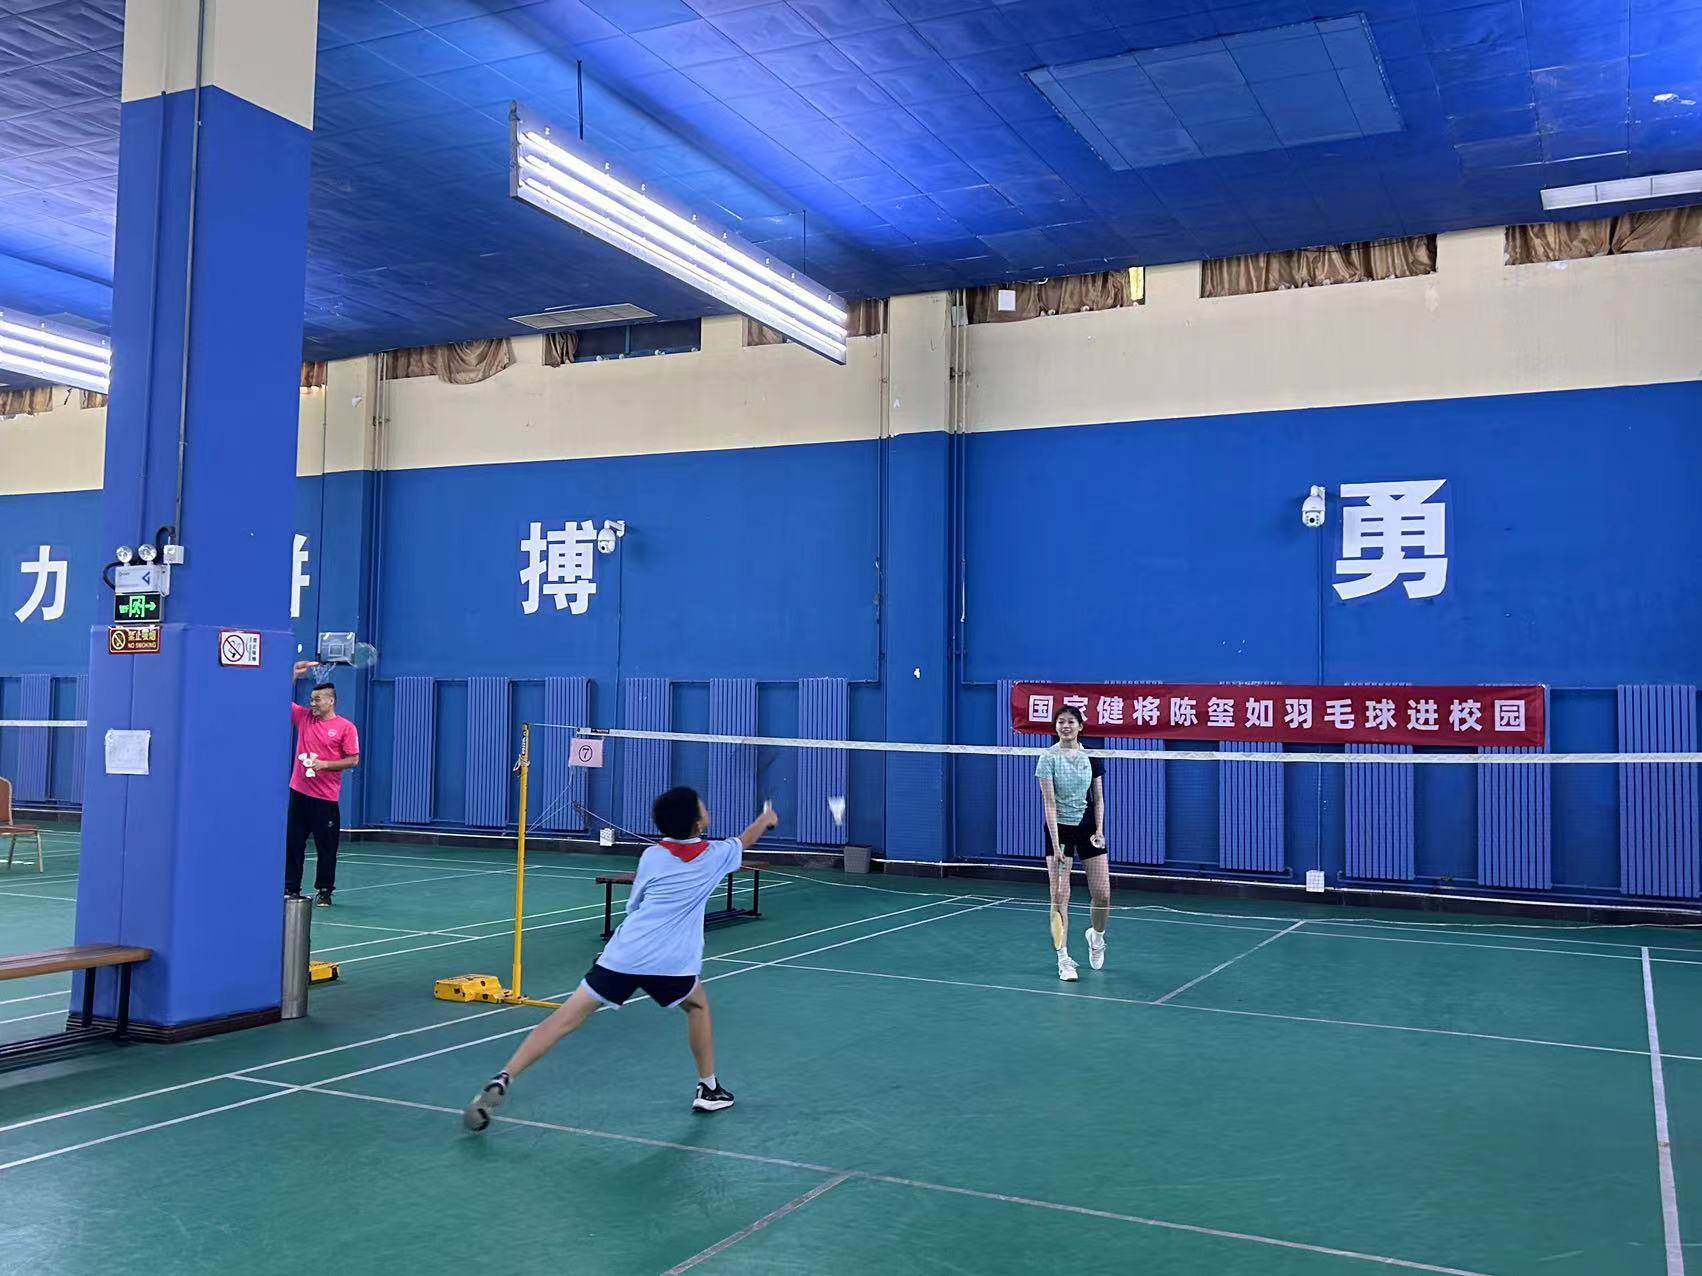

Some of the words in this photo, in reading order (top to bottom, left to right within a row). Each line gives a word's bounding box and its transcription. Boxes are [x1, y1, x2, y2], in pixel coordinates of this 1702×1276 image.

[14, 545, 68, 623] 力
[519, 520, 597, 615] 搏
[1332, 479, 1448, 600] 勇
